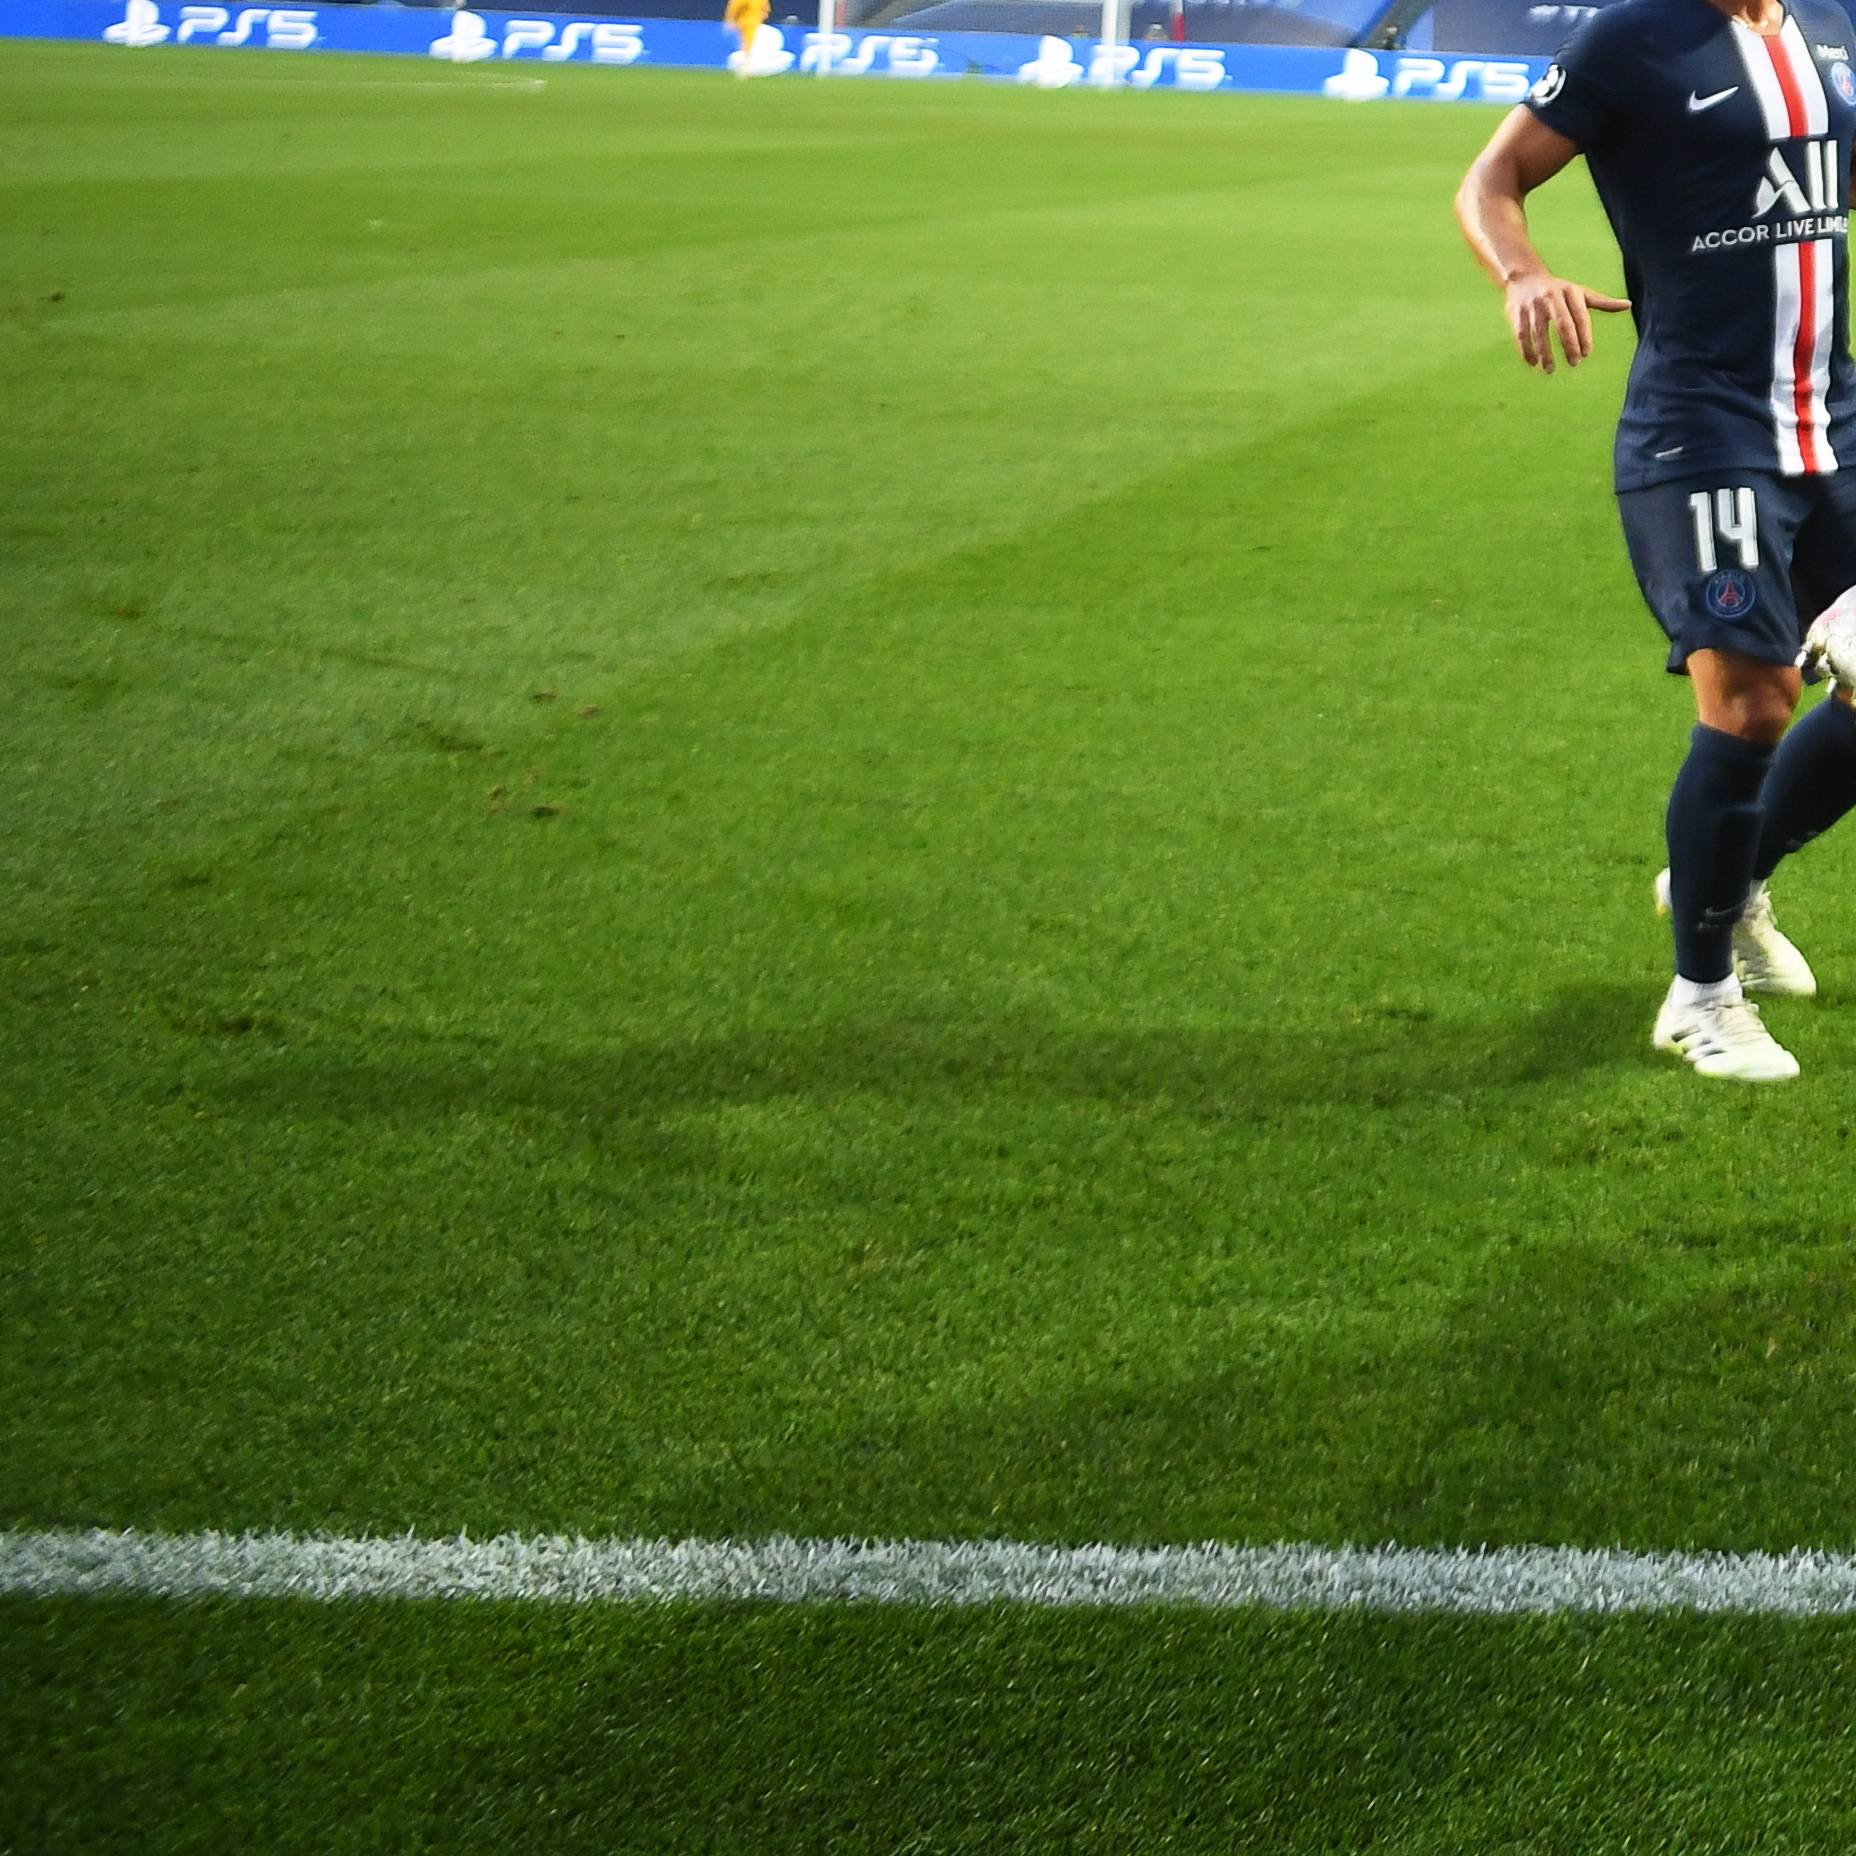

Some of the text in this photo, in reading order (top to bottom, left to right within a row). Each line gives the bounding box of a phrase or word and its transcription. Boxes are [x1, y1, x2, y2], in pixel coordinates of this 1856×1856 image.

[177, 6, 319, 48] PS5
[502, 20, 645, 64] PS5
[802, 32, 940, 77] PS5
[1088, 44, 1226, 90] PS5
[1393, 56, 1530, 101] PS5
[1692, 224, 1770, 253] ACCOR
[1776, 217, 1814, 239] LIVE
[1689, 487, 1759, 572] 14
